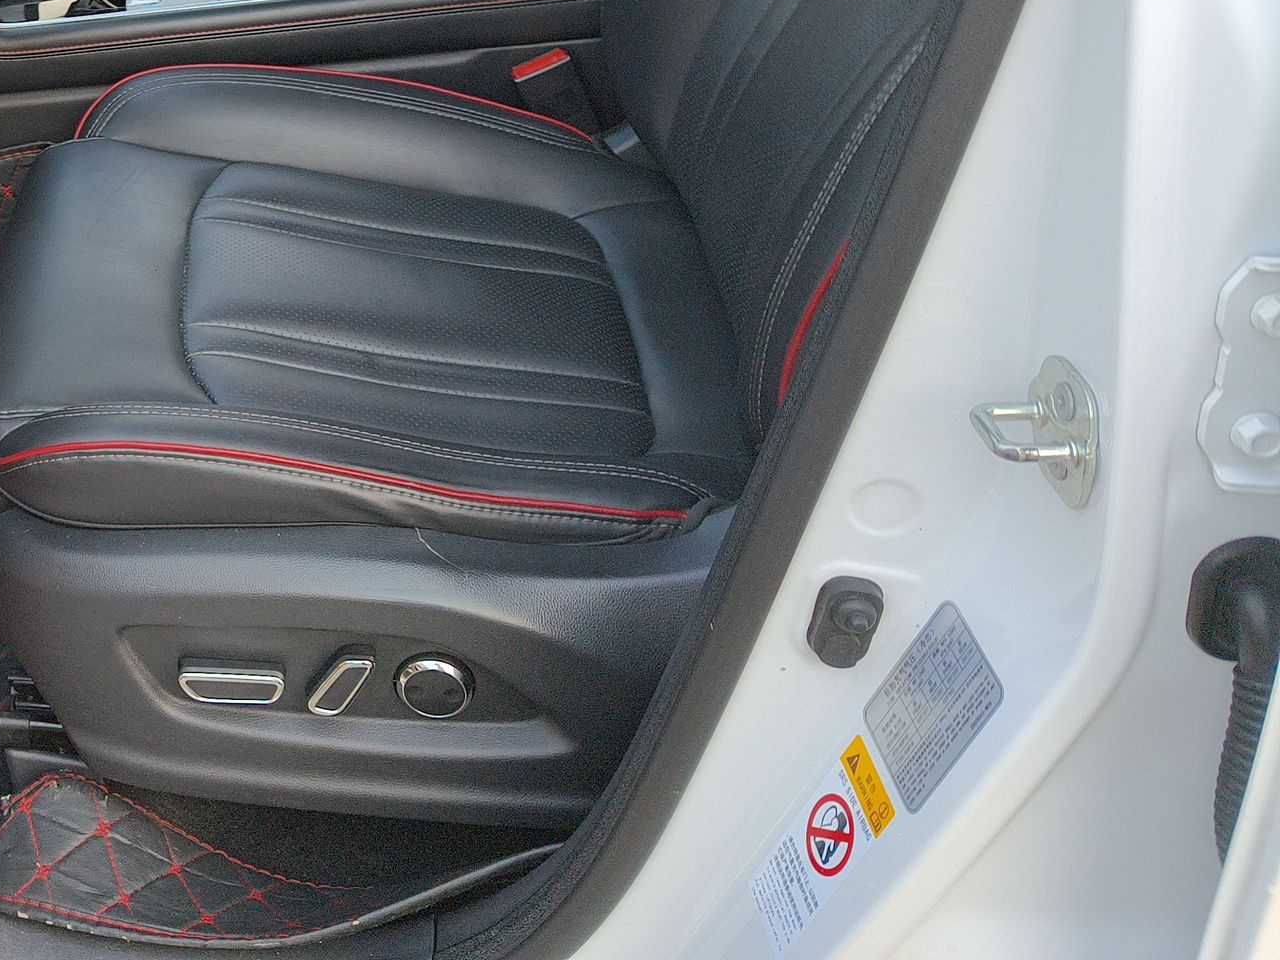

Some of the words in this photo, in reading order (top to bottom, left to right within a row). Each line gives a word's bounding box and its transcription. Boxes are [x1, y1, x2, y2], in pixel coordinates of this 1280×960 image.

[838, 769, 847, 787] SRS
[846, 786, 858, 808] SIDE
[855, 809, 872, 842] AIRBAG
[855, 776, 873, 812] WARNING
